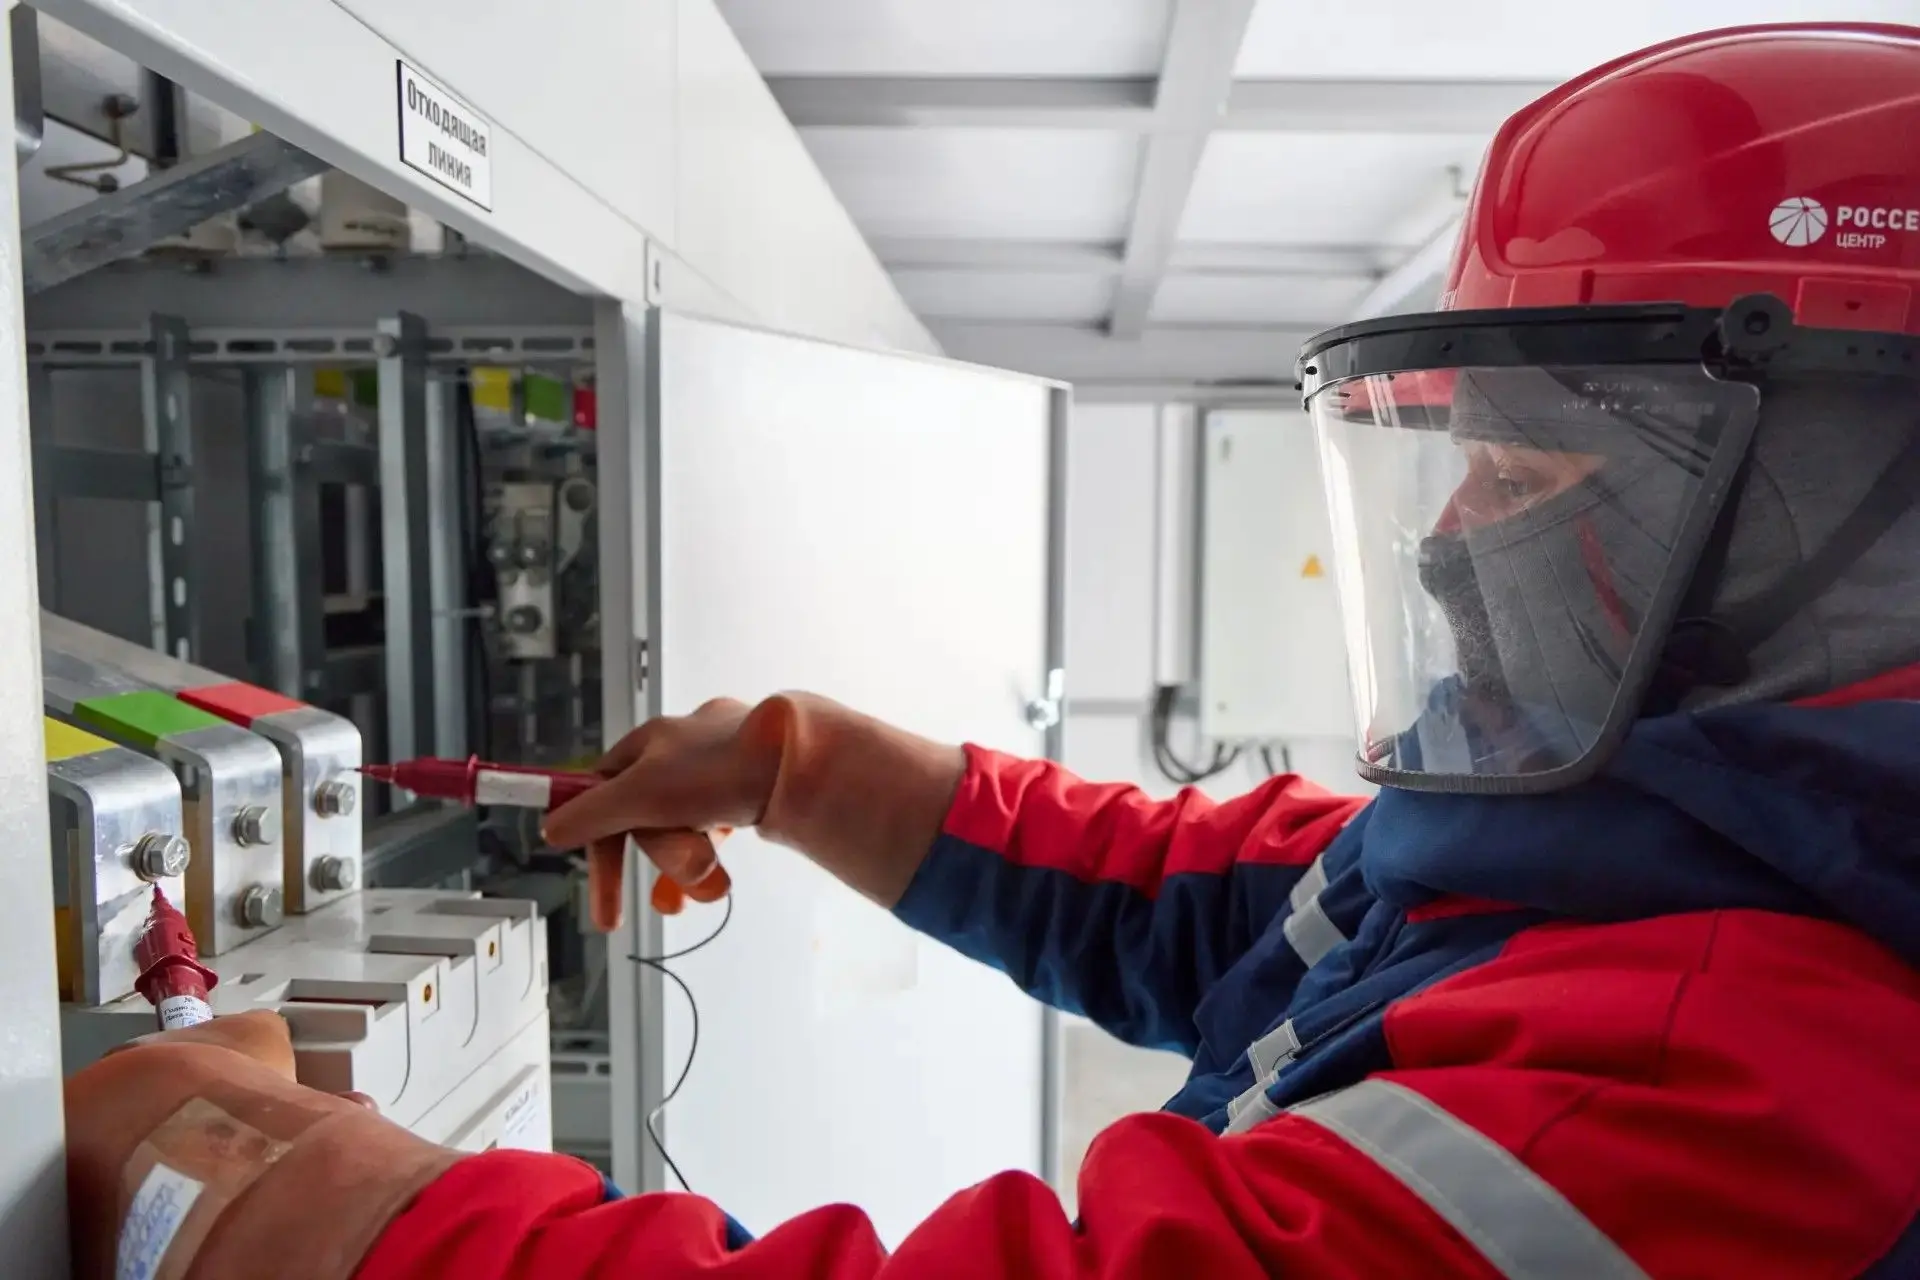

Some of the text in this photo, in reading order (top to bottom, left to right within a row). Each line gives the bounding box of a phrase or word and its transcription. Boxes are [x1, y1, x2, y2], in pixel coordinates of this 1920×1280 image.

[407, 78, 486, 157] Отходящая
[1836, 206, 1920, 231] РОССЕ
[1836, 233, 1886, 249] ЦЕНТР
